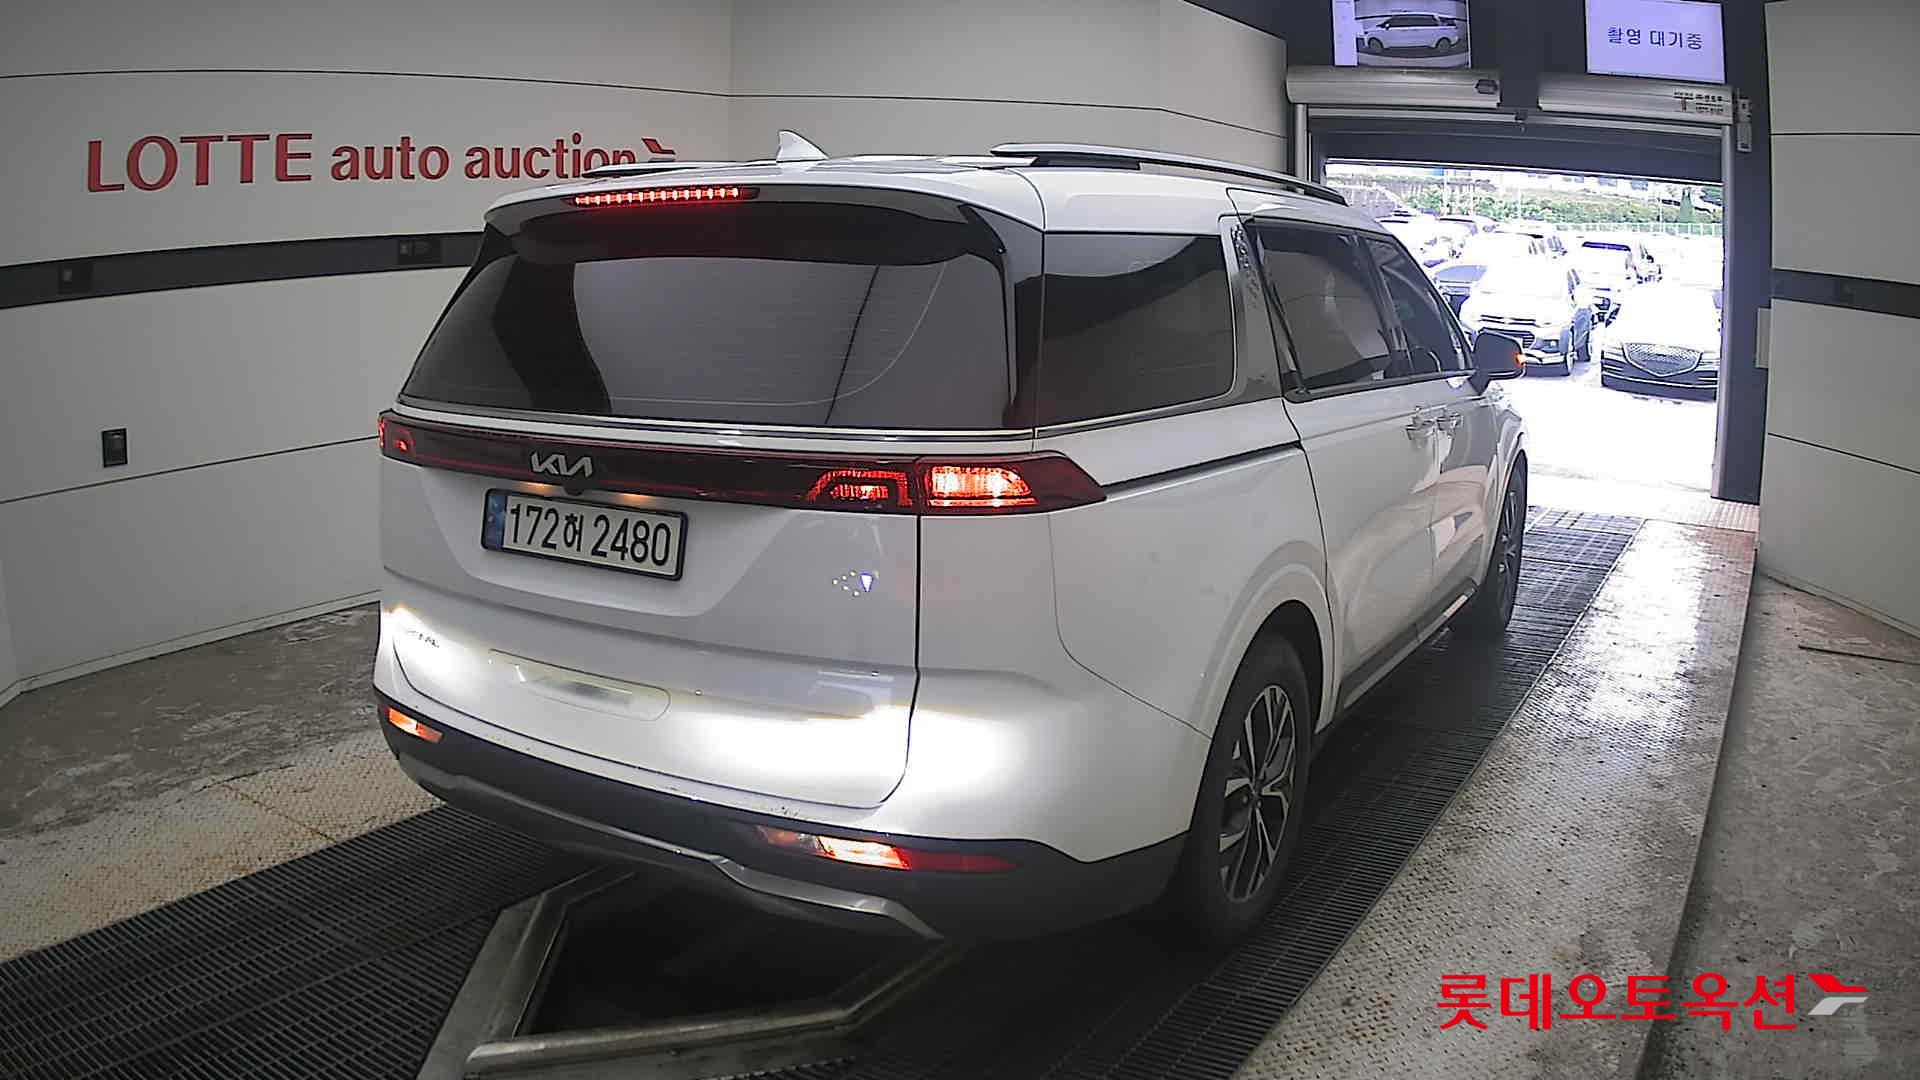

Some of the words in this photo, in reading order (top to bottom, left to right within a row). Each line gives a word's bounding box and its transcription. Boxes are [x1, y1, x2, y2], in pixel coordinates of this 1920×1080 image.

[1649, 30, 1703, 50] 대기중
[87, 133, 312, 192] LOTTE
[330, 138, 449, 180] auto
[510, 502, 584, 553] 172허
[591, 513, 671, 566] 2480
